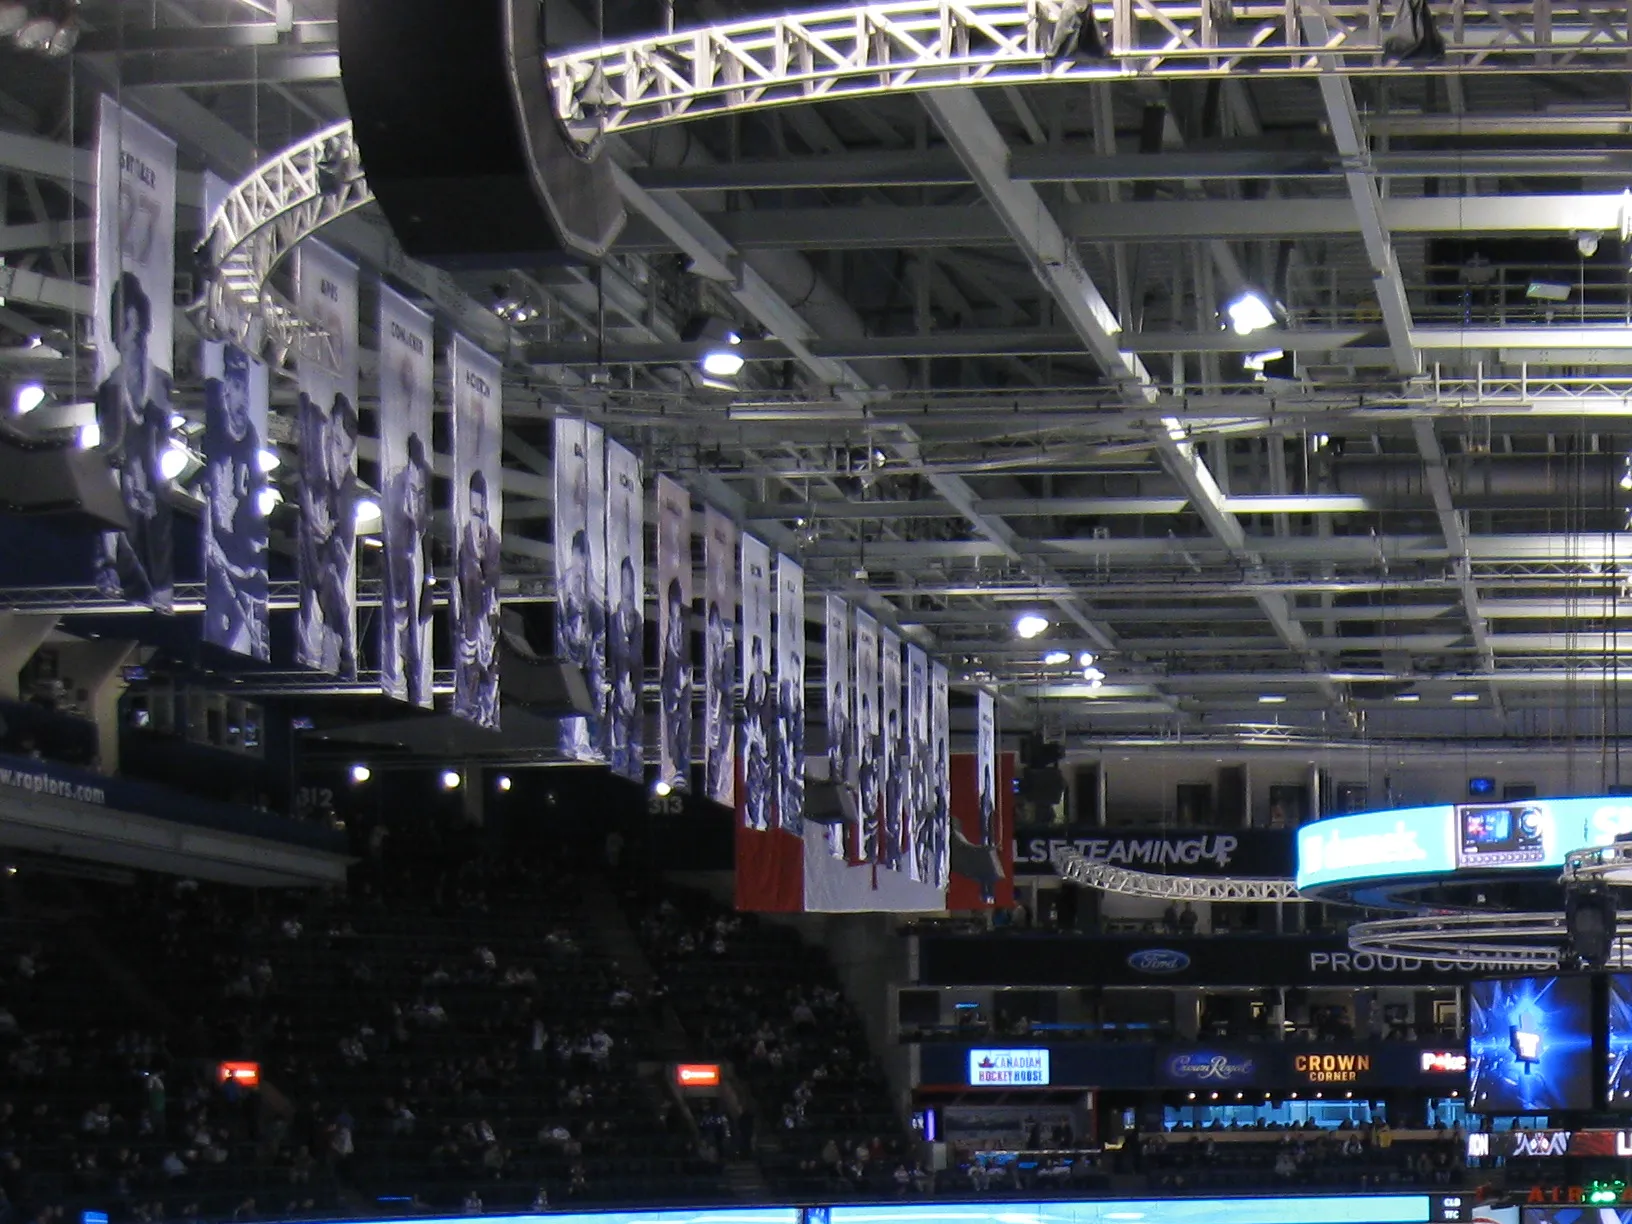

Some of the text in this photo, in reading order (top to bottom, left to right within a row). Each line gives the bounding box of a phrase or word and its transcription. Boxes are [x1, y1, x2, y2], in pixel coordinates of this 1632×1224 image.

[1140, 952, 1179, 969] Ford
[1310, 952, 1422, 972] PROUD
[994, 1056, 1042, 1068] CANADIAN
[1172, 1054, 1253, 1080] Crown Royal
[1295, 1054, 1370, 1071] CROWN
[1309, 1072, 1357, 1082] CORNER
